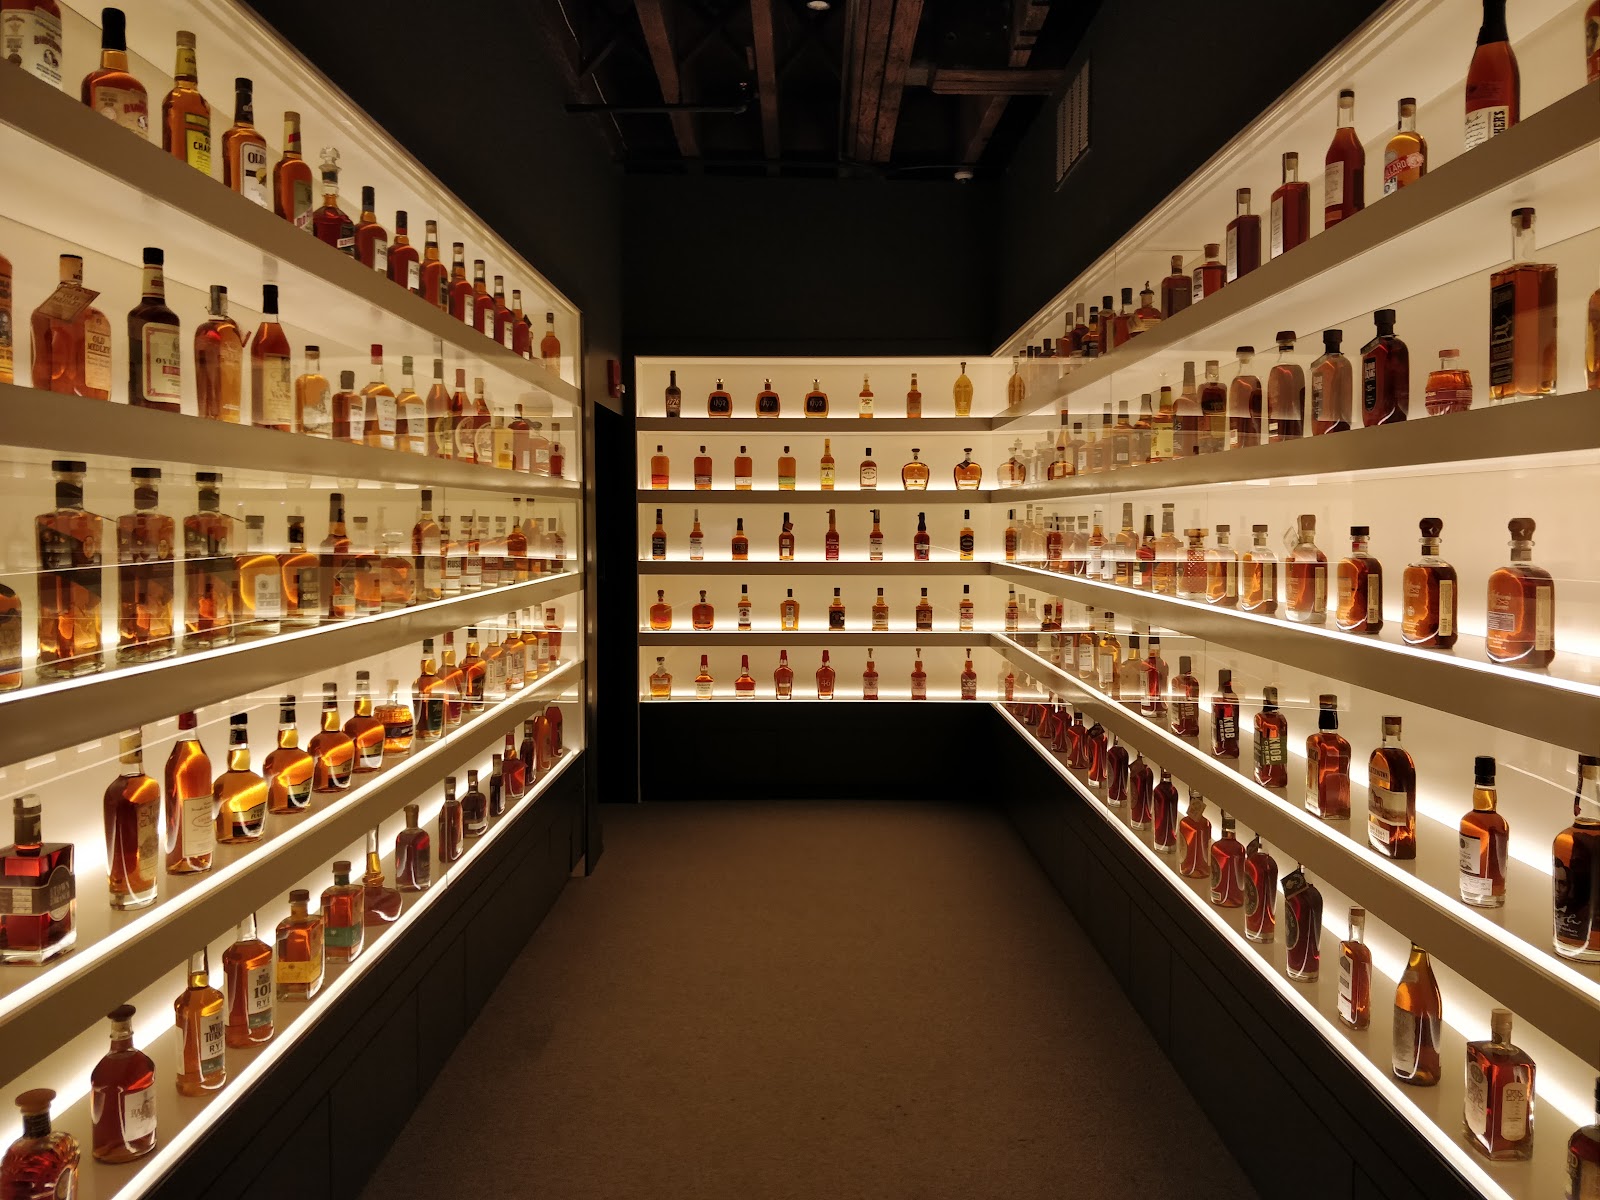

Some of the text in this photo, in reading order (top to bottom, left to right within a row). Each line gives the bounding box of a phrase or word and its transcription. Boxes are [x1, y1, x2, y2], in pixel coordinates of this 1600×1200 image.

[87, 343, 110, 353] MEDLEY
[92, 335, 105, 345] OLD
[1223, 716, 1236, 739] KNOB
[1269, 737, 1282, 762] KNOB
[254, 983, 271, 999] 101
